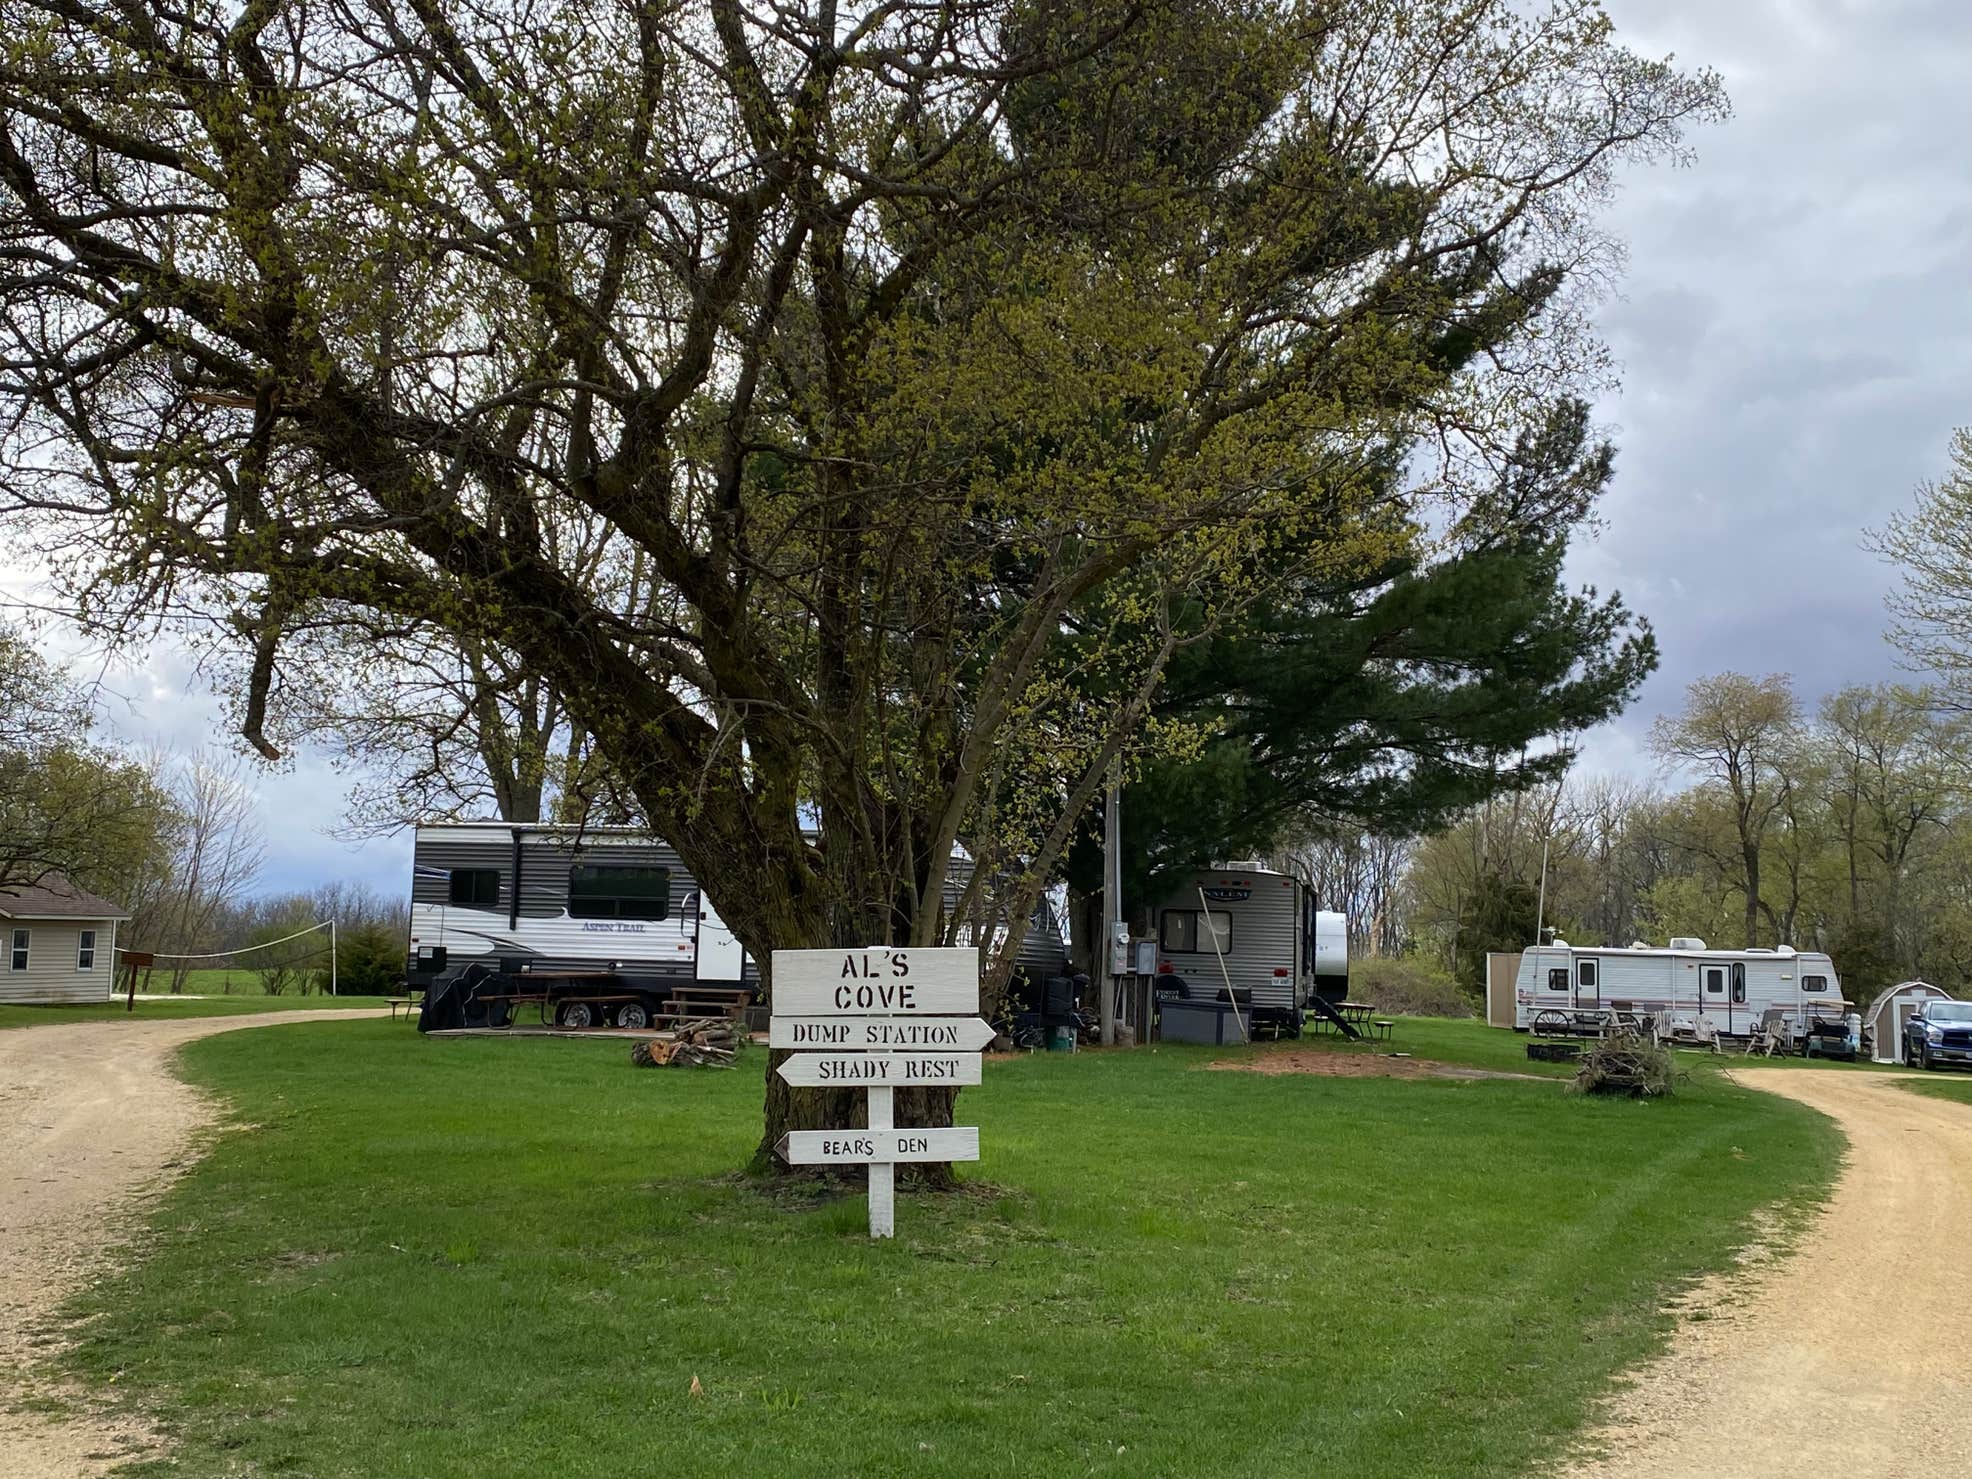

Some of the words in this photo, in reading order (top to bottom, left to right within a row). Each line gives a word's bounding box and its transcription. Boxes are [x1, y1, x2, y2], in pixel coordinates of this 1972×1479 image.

[582, 922, 613, 931] ASPEN
[615, 922, 647, 933] TRAIL
[841, 950, 909, 979] AL'S
[834, 984, 917, 1010] COVE
[792, 1023, 851, 1044] DUMP
[866, 1025, 959, 1045] STATION
[818, 1060, 891, 1080] SHADY
[905, 1060, 960, 1080] REST
[823, 1137, 875, 1156] BEAR'S
[897, 1137, 928, 1154] DEN
